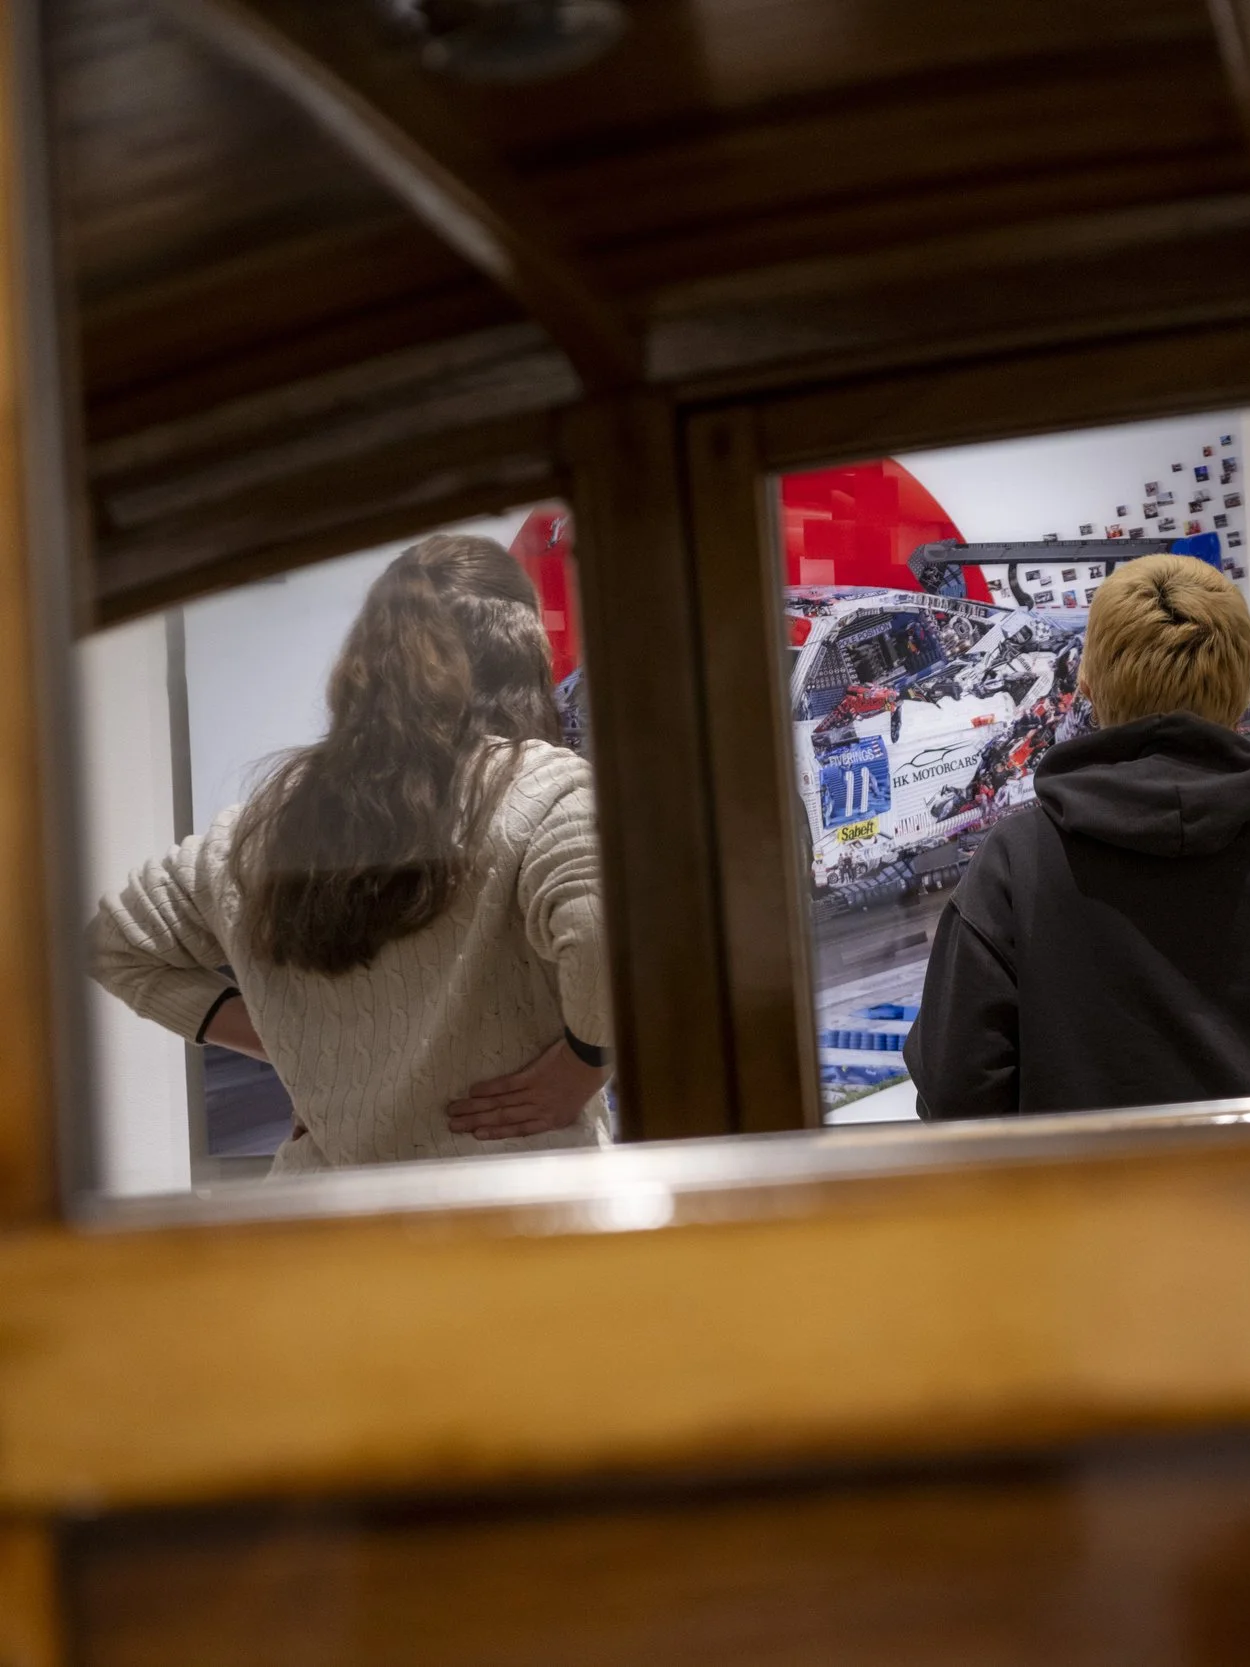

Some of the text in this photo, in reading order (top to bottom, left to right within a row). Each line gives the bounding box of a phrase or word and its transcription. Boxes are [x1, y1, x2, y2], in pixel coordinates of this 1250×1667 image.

[859, 621, 893, 640] POSITION
[892, 755, 979, 789] HK MOTORCARS
[845, 767, 870, 817] 11
[841, 821, 874, 842] Sabelt
